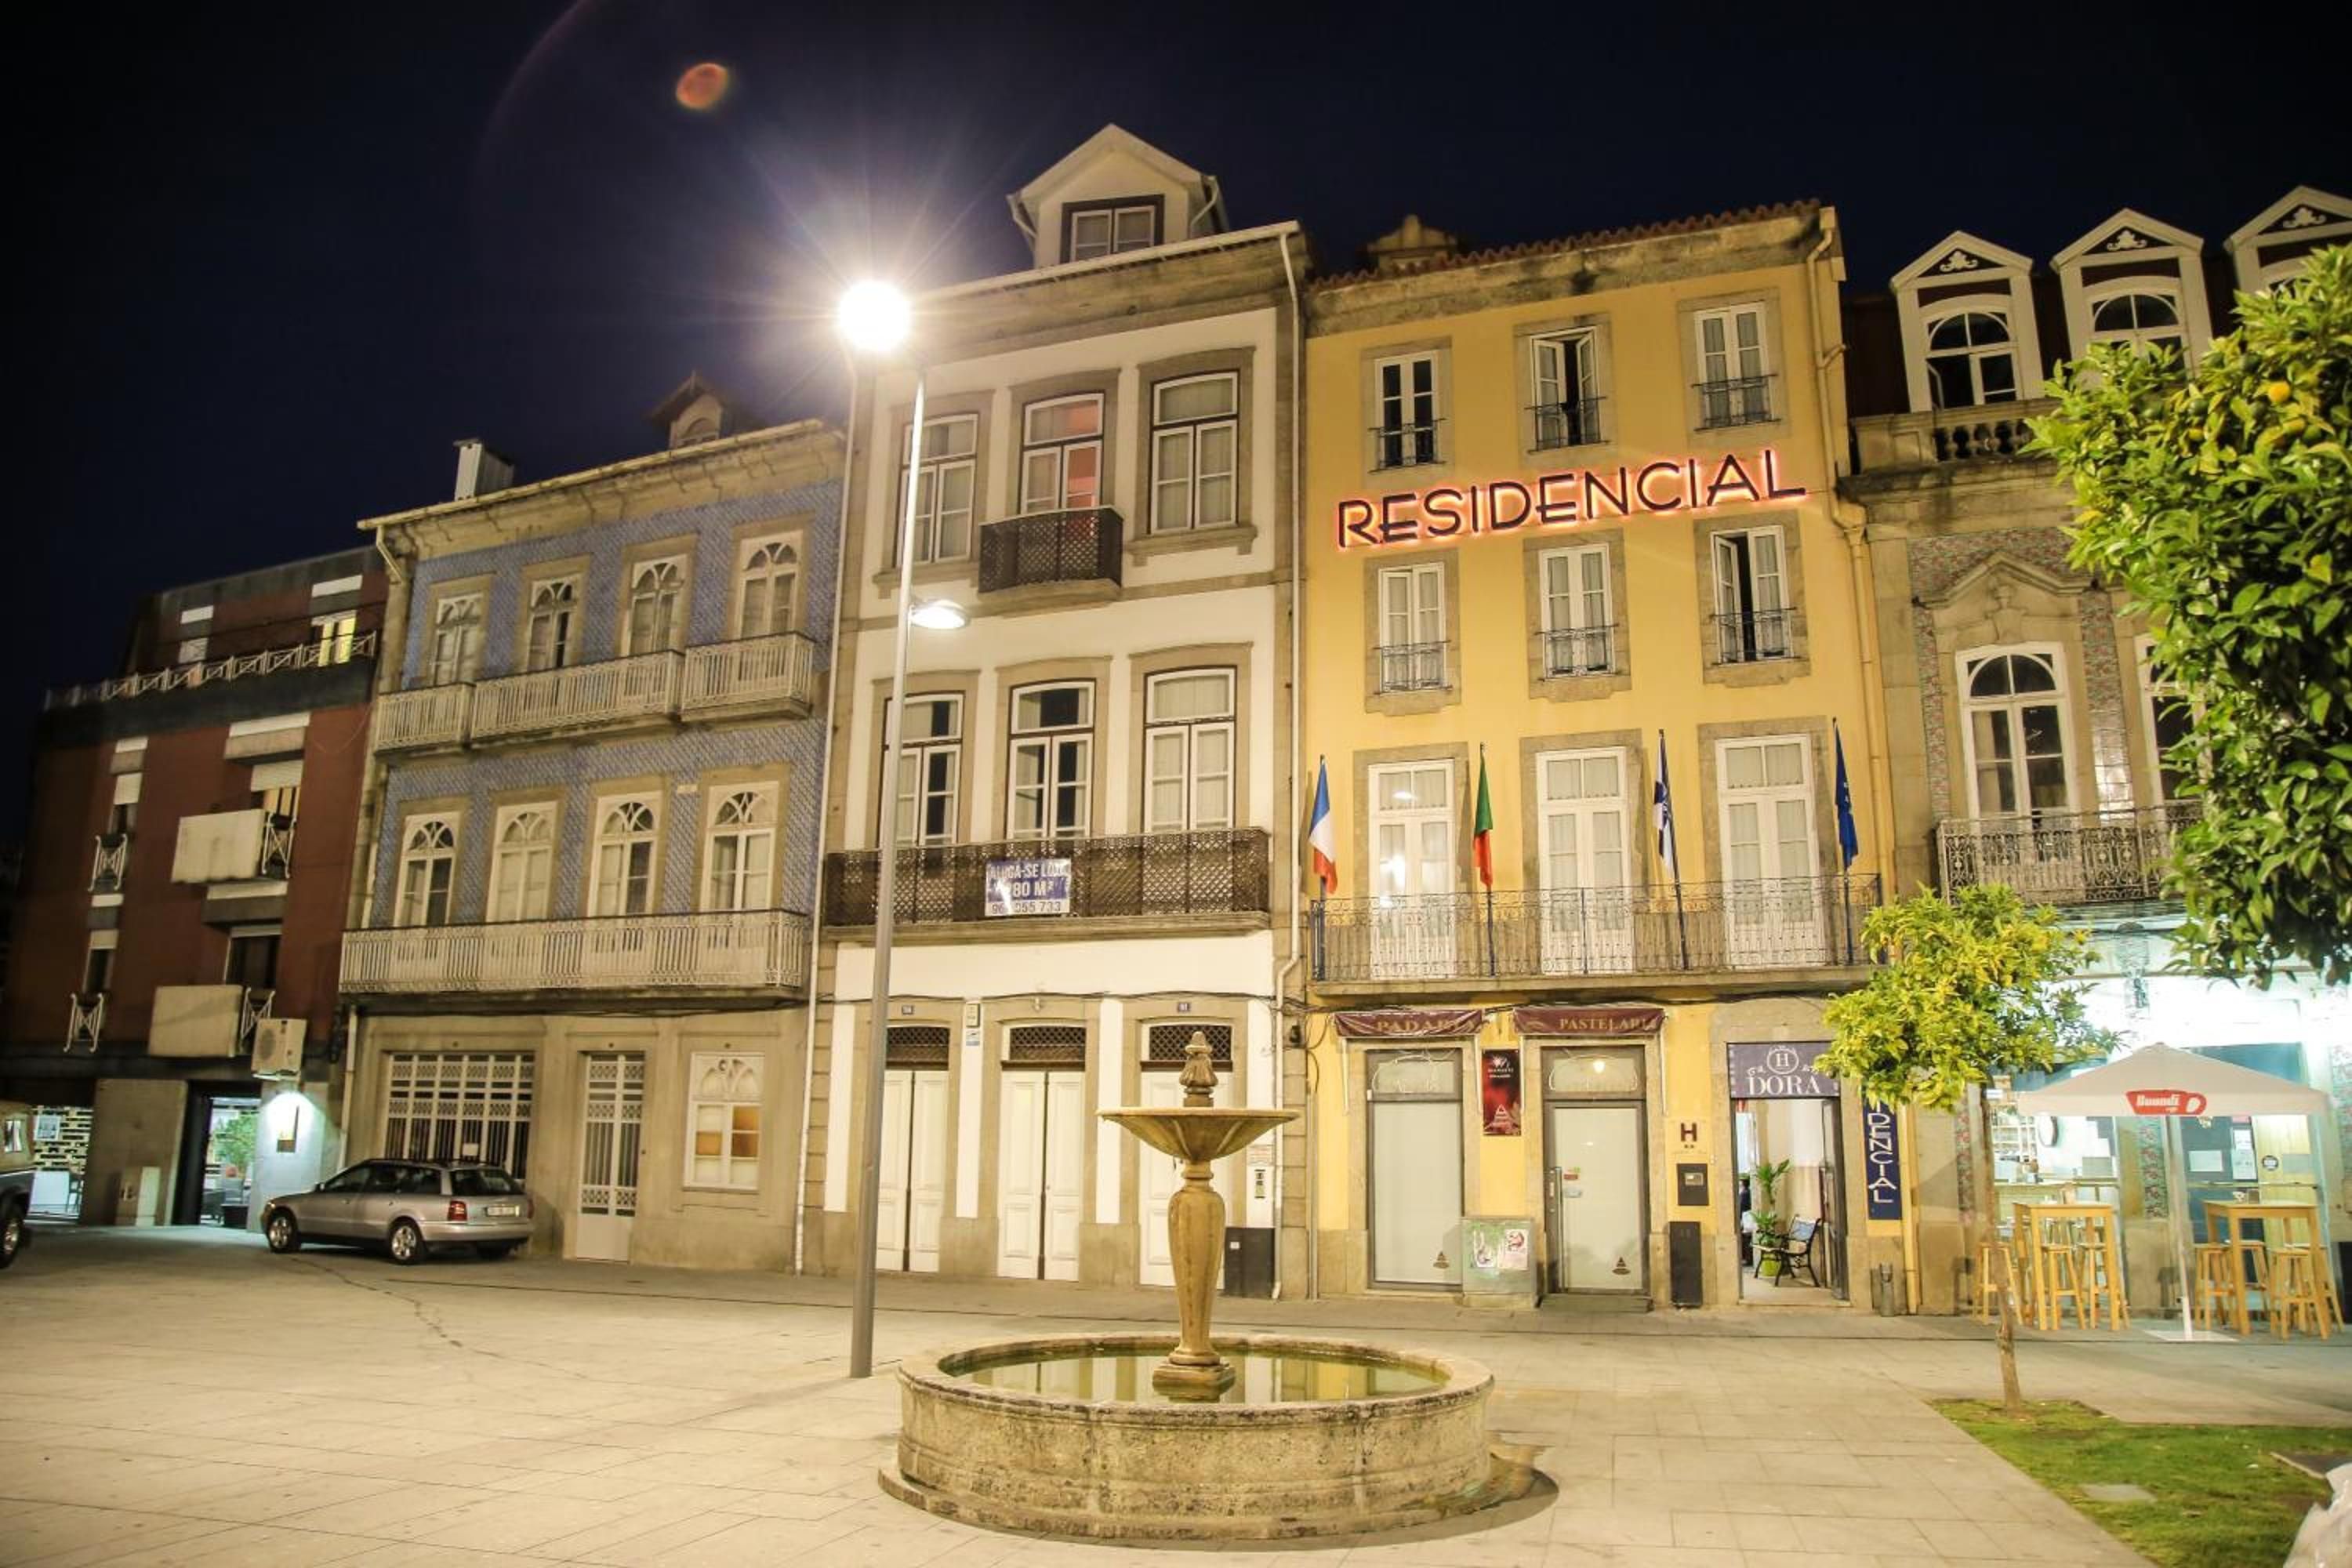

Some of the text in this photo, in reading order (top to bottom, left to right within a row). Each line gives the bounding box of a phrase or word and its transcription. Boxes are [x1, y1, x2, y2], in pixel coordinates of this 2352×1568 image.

[1338, 448, 1806, 549] RESIDENCIAL
[1775, 1052, 1790, 1067] H
[1745, 1074, 1821, 1096] DORA
[1680, 1122, 1697, 1142] H
